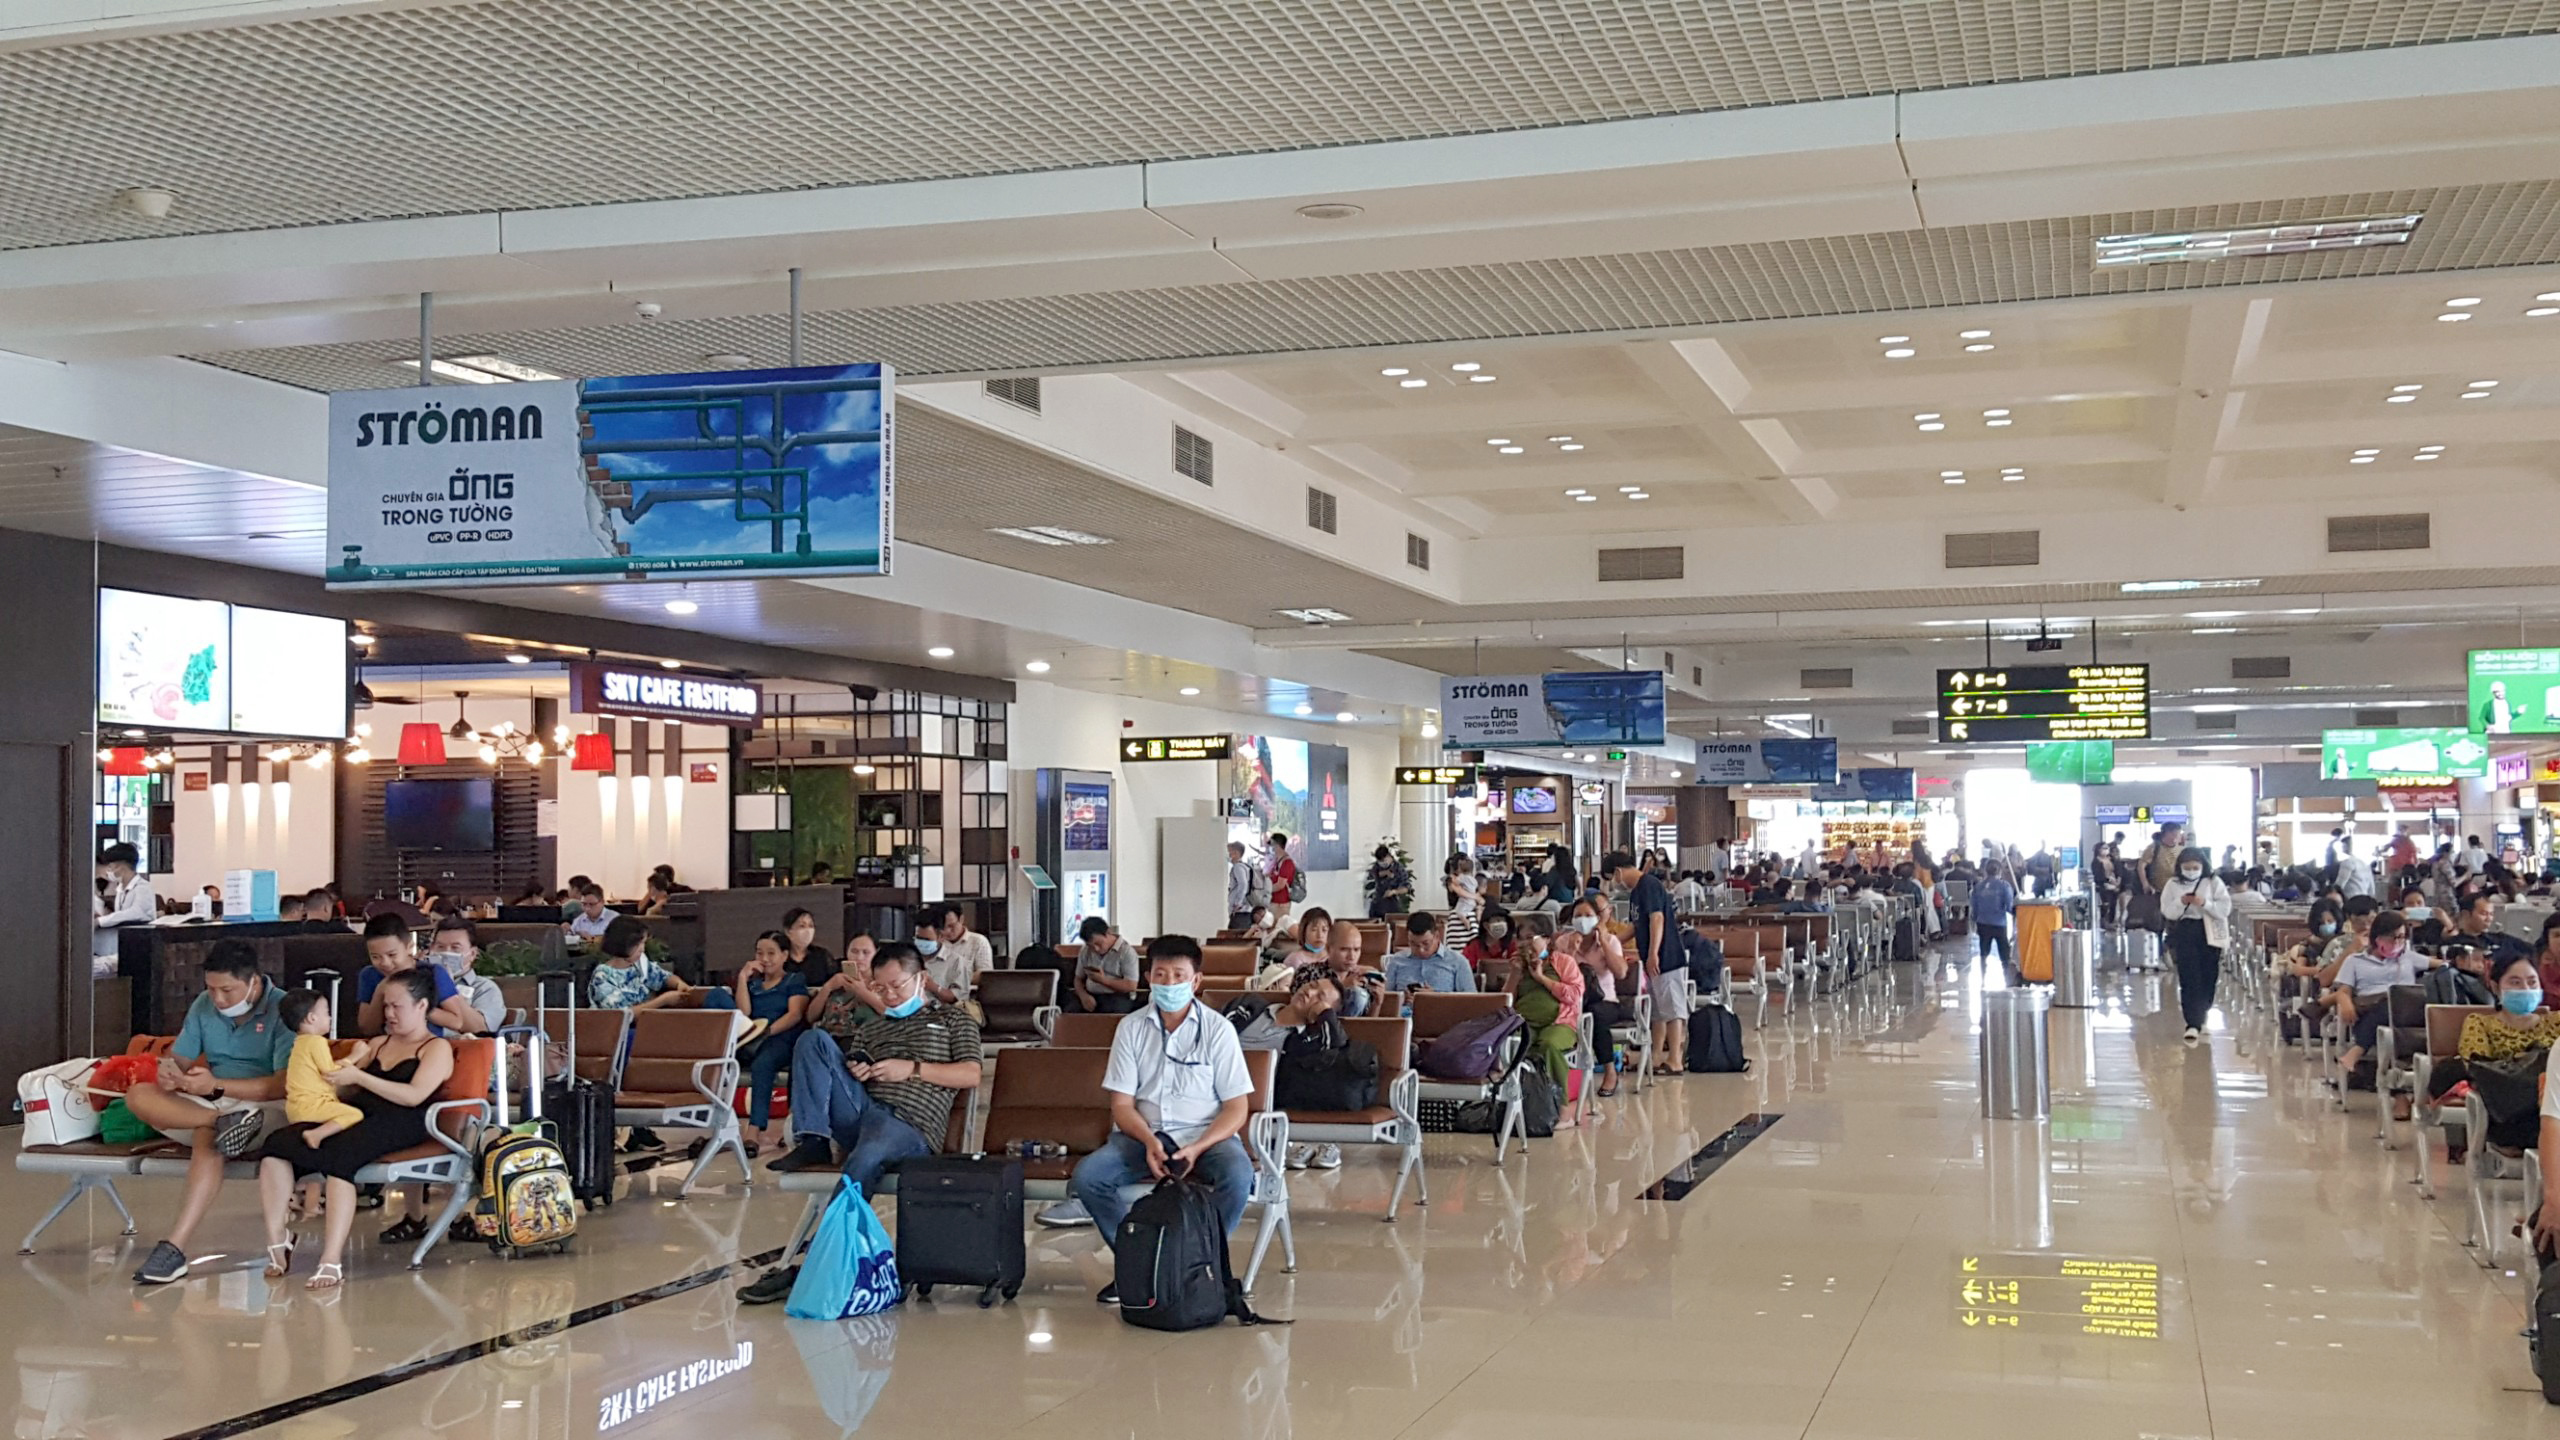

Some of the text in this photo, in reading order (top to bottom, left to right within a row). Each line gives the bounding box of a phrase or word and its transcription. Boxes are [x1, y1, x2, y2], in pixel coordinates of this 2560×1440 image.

[382, 491, 423, 504] CHUYÊN
[426, 492, 445, 502] GIA
[382, 502, 513, 526] TRONG TƯỜNG
[487, 531, 510, 540] HDPE
[635, 562, 651, 570] 1900
[679, 558, 744, 568] www.stroman.vn
[603, 671, 639, 702] SKY
[640, 676, 682, 707] CAFE
[683, 681, 757, 715] FASTFOOD
[2137, 807, 2147, 818] 6
